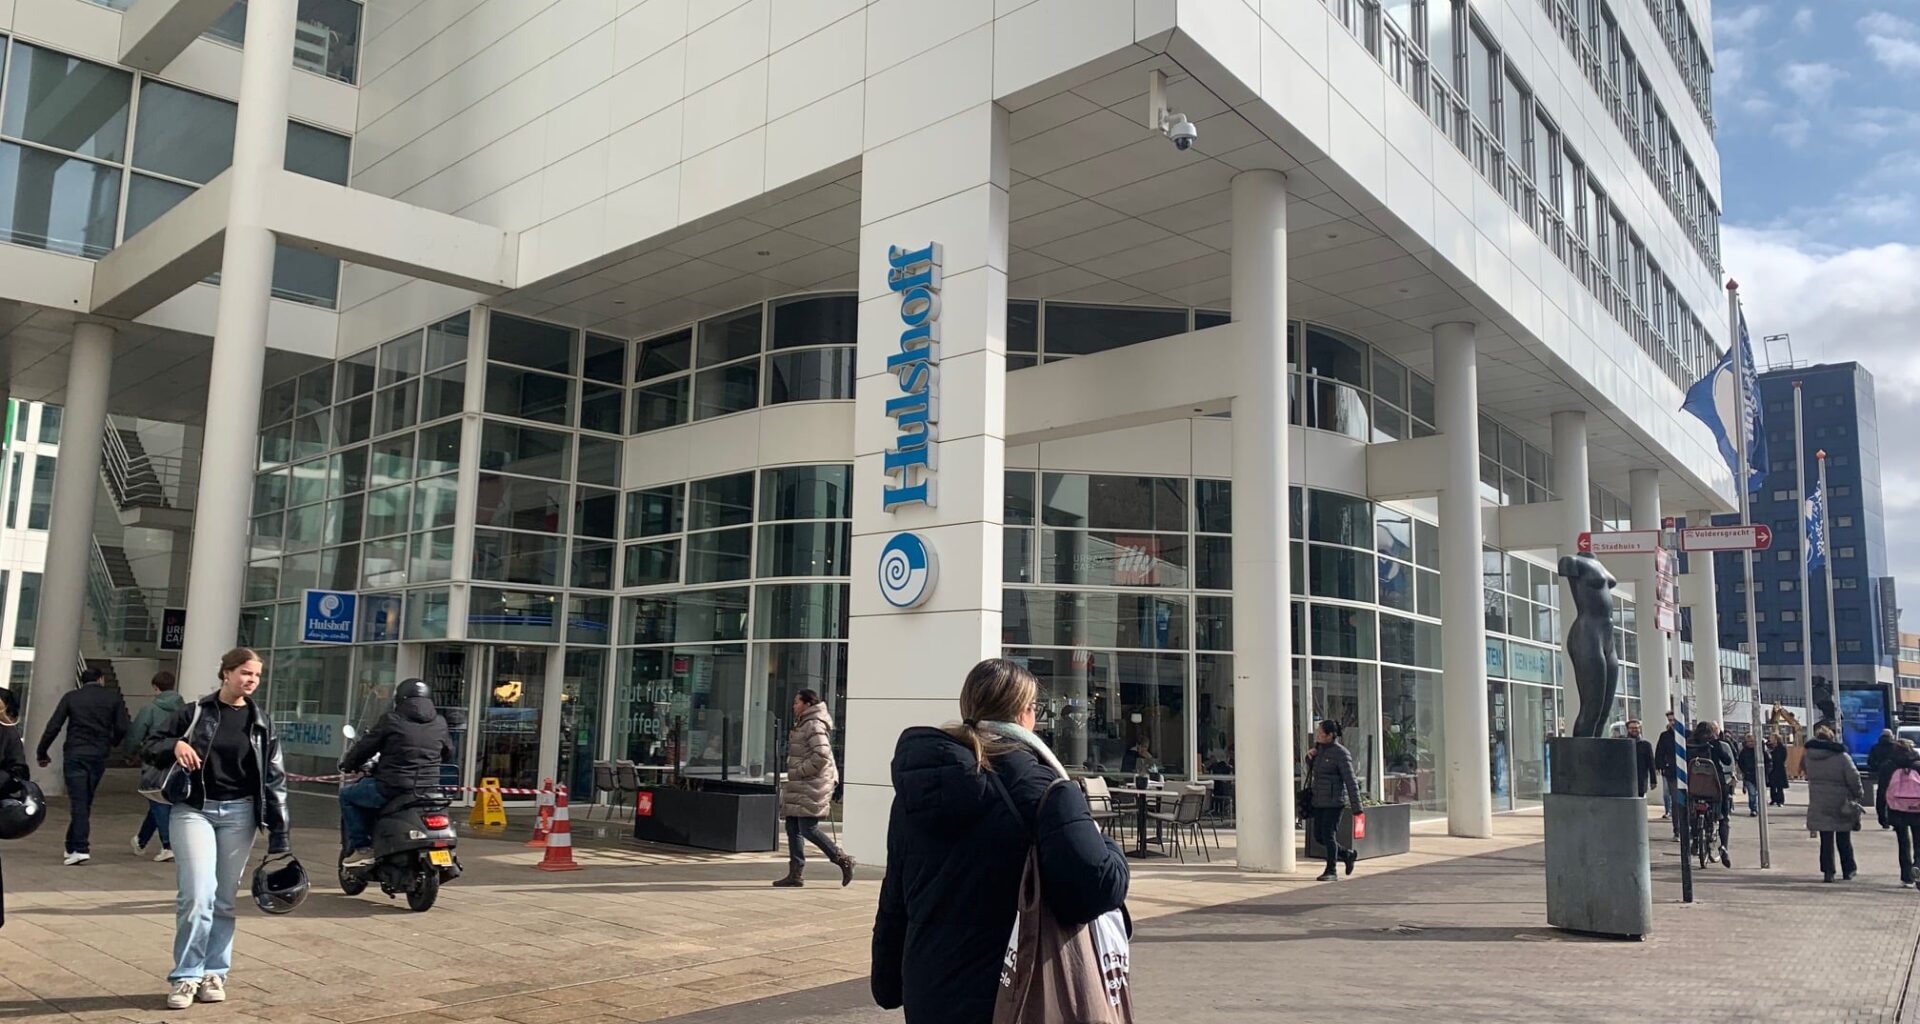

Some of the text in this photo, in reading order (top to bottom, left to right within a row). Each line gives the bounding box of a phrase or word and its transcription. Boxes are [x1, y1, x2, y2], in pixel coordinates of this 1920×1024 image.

[882, 241, 943, 514] Hulshoff
[1695, 529, 1750, 539] Voldersgracht
[309, 618, 351, 632] Hulshoff
[618, 712, 660, 735] coffee
